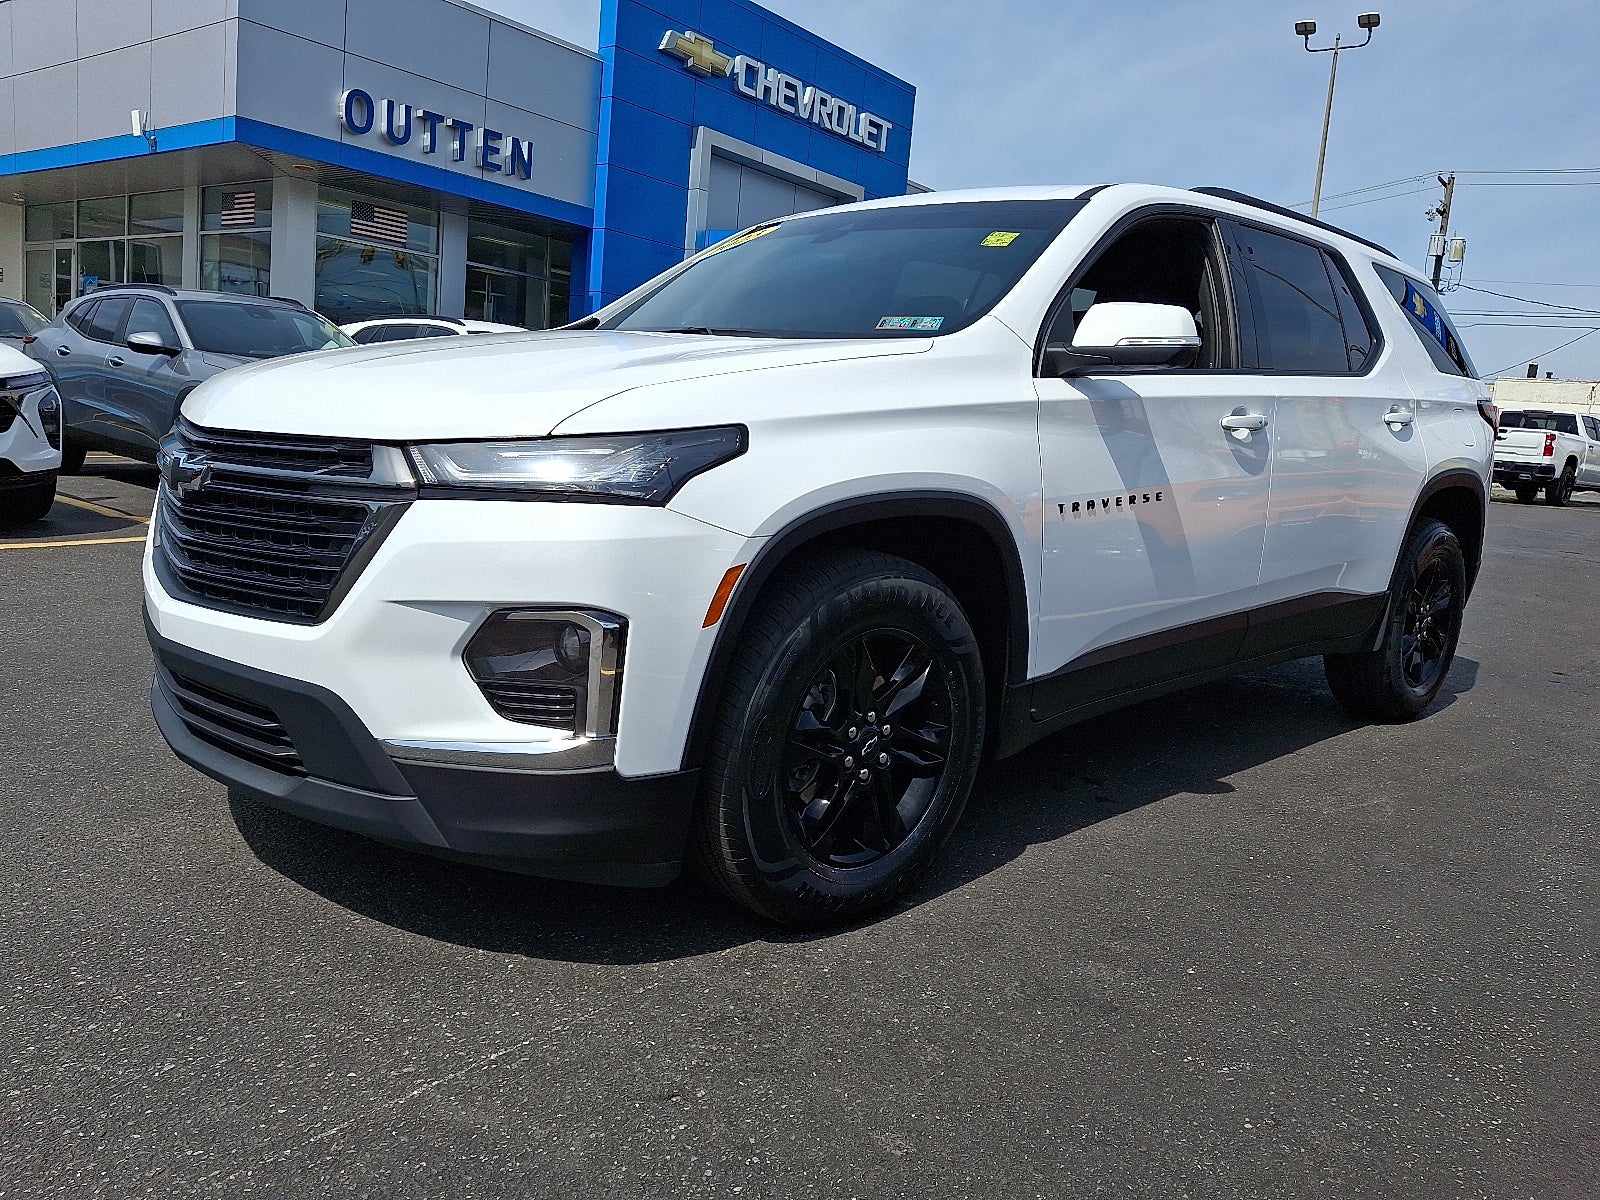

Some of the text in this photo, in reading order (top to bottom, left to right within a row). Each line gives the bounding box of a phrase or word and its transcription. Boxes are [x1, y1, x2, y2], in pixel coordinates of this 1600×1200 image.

[340, 88, 533, 180] OUTTEN
[735, 55, 892, 152] CHEVROLET
[1058, 492, 1162, 514] TRAVERSE
